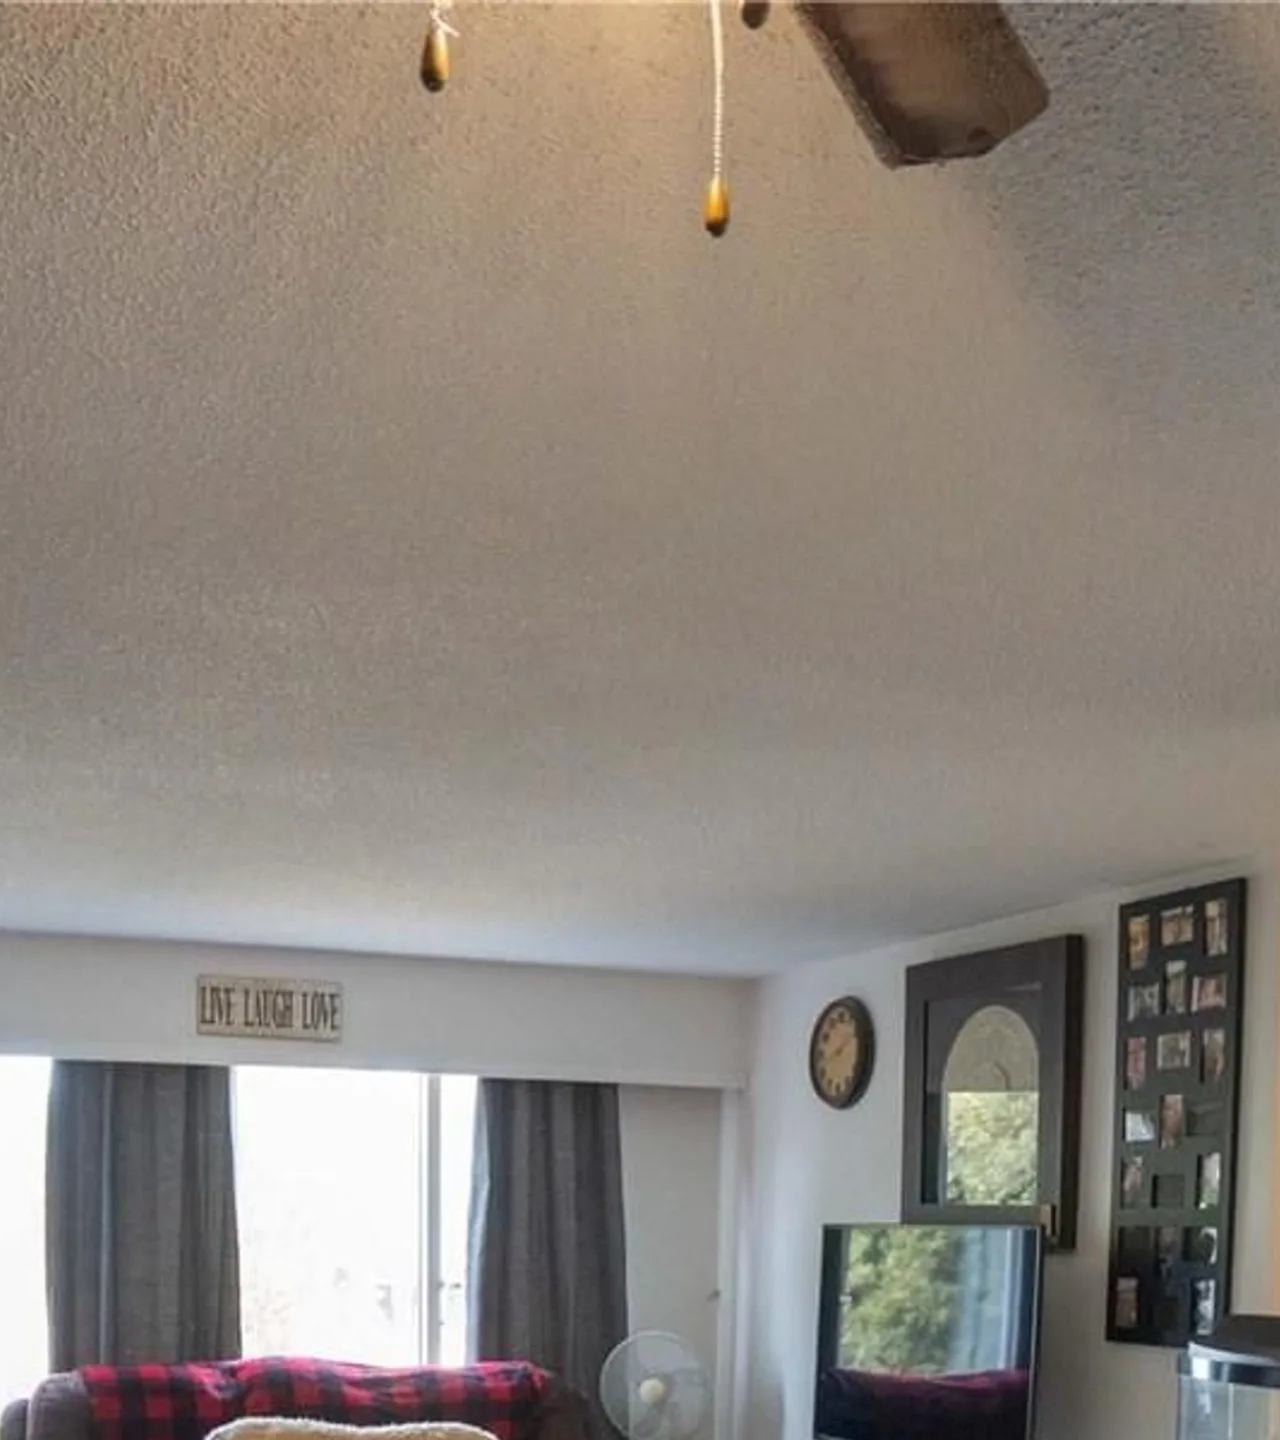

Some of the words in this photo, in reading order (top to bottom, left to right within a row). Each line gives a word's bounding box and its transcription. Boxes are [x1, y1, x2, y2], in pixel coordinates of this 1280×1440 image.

[200, 986, 235, 1026] LIVE
[243, 988, 295, 1028] LAUGH
[302, 991, 341, 1030] LOVE
